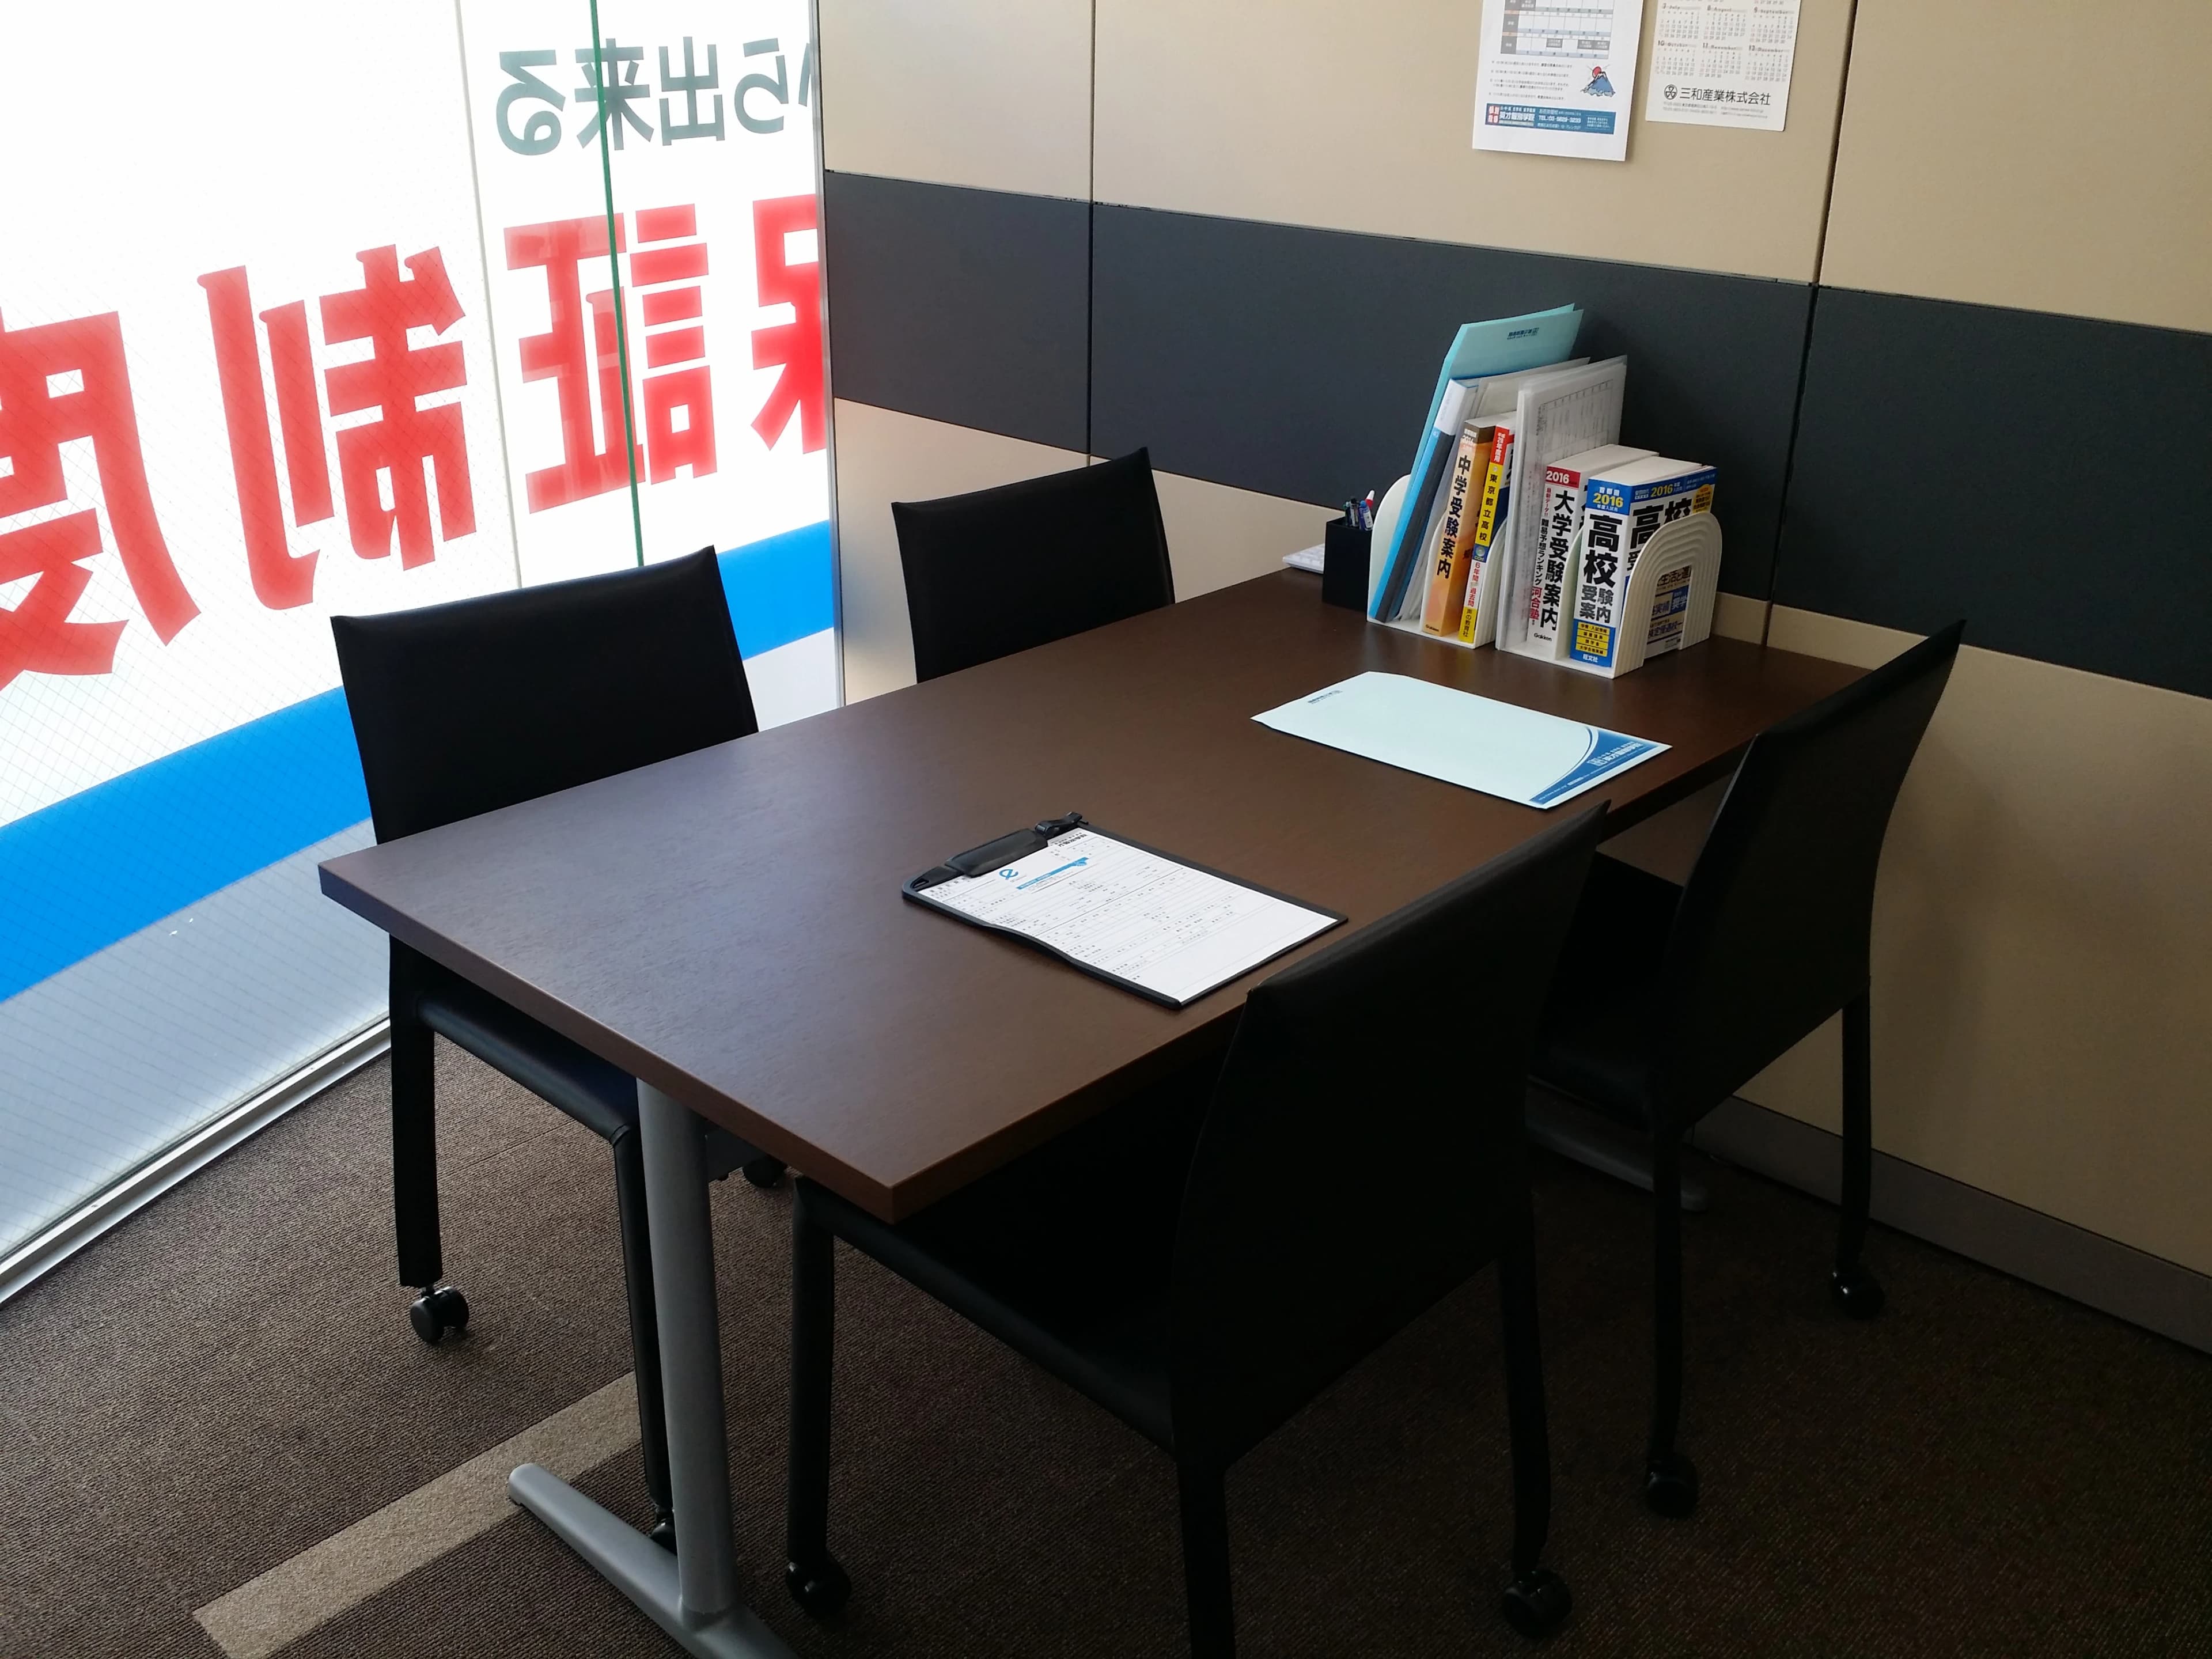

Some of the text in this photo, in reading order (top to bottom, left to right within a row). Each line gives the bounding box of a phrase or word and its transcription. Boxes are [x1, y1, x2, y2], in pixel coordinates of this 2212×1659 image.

[1679, 88, 1771, 105] 三和産業株式会社
[1546, 470, 1570, 484] 2016
[1593, 493, 1623, 507] 2016
[1650, 484, 1673, 498] 2016
[1437, 455, 1471, 579] 中学受験案内
[1479, 474, 1498, 541] 東京都立高校
[1540, 490, 1575, 631] 大学受験案内
[1583, 513, 1623, 588] 高校
[1529, 586, 1543, 620] 河合塾
[1581, 584, 1613, 607] 受験
[1580, 601, 1611, 623] 案内
[1534, 632, 1552, 642] Gakken
